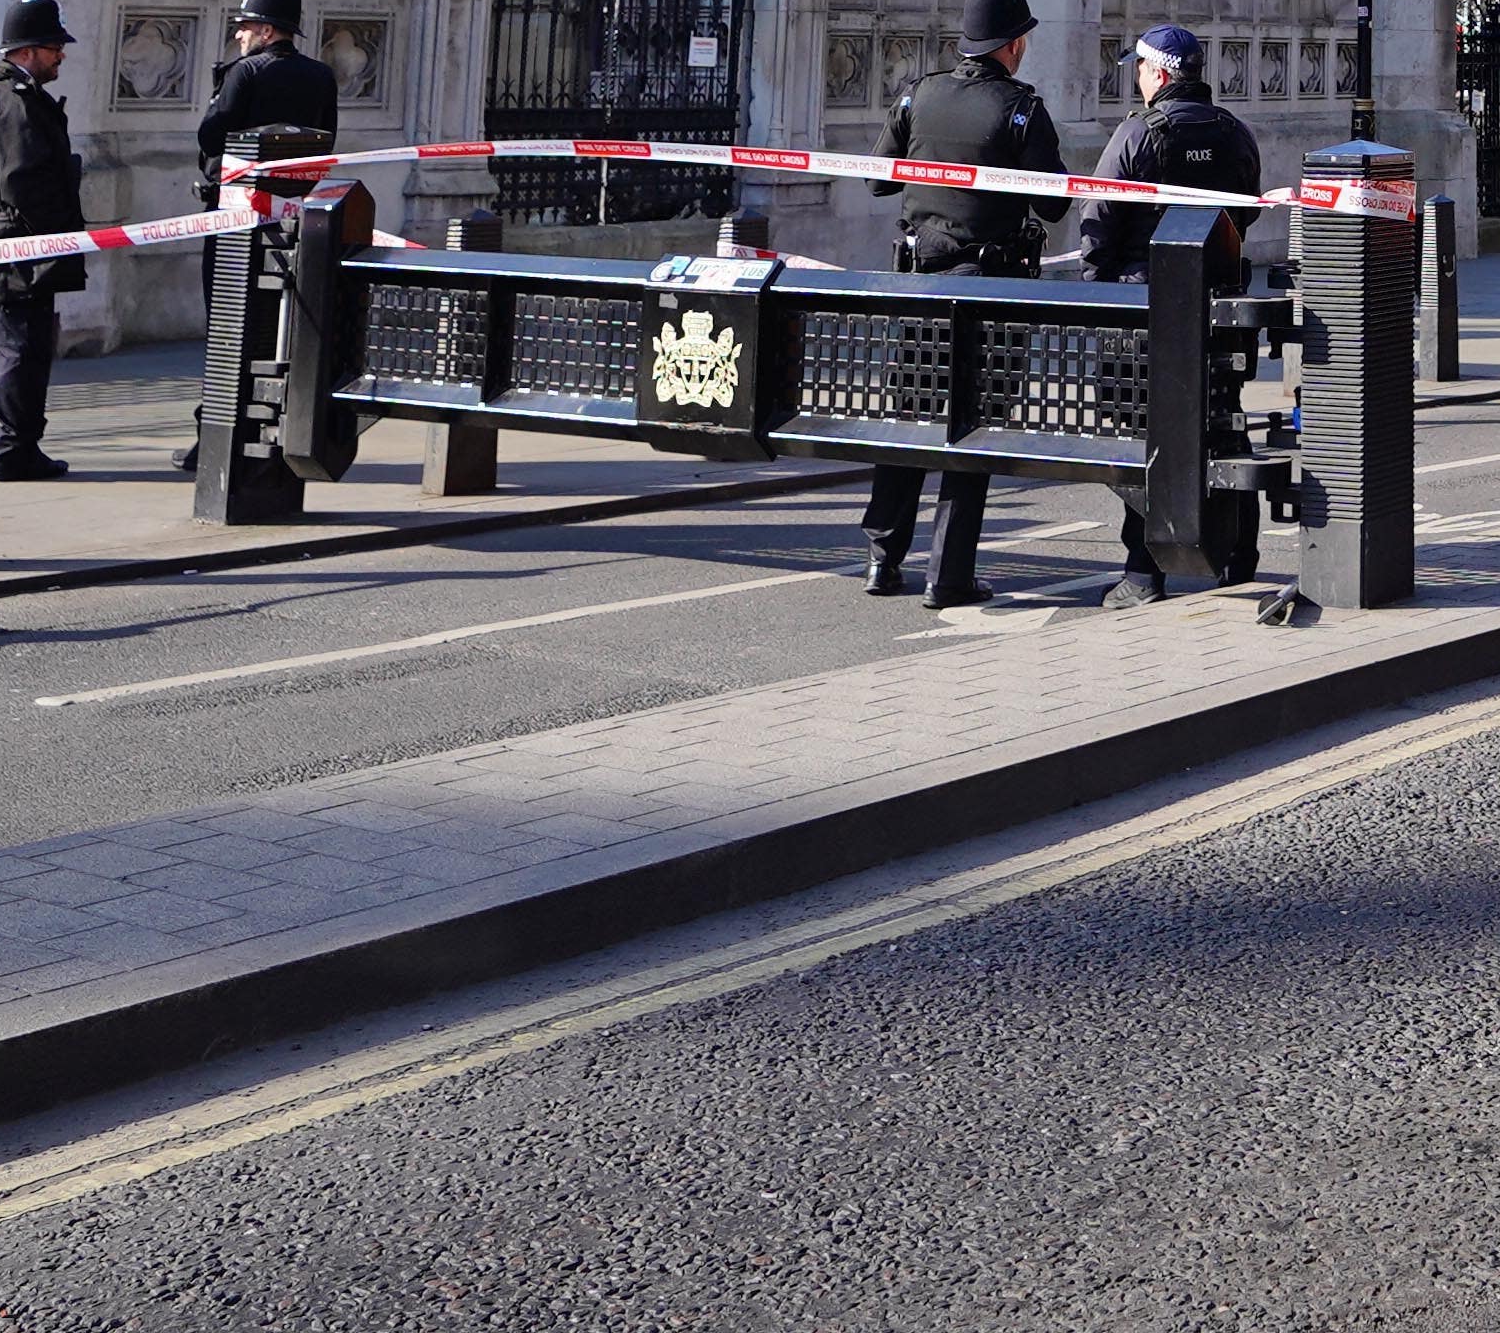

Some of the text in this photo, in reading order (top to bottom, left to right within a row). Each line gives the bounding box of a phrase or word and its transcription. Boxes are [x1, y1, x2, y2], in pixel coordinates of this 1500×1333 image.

[577, 144, 594, 152] FIRE
[622, 144, 648, 153] CROSS
[1186, 149, 1213, 161] POLICE
[734, 152, 807, 165] FIRE DO NOT CROSS
[896, 165, 972, 182] FIRE DO NOT CROSS
[1301, 187, 1333, 202] CROSS
[143, 221, 183, 241] POLICE
[186, 215, 212, 235] LINE
[214, 213, 230, 231] DO
[232, 209, 256, 228] NOT
[13, 238, 39, 260] NOT
[40, 235, 80, 257] CROSS
